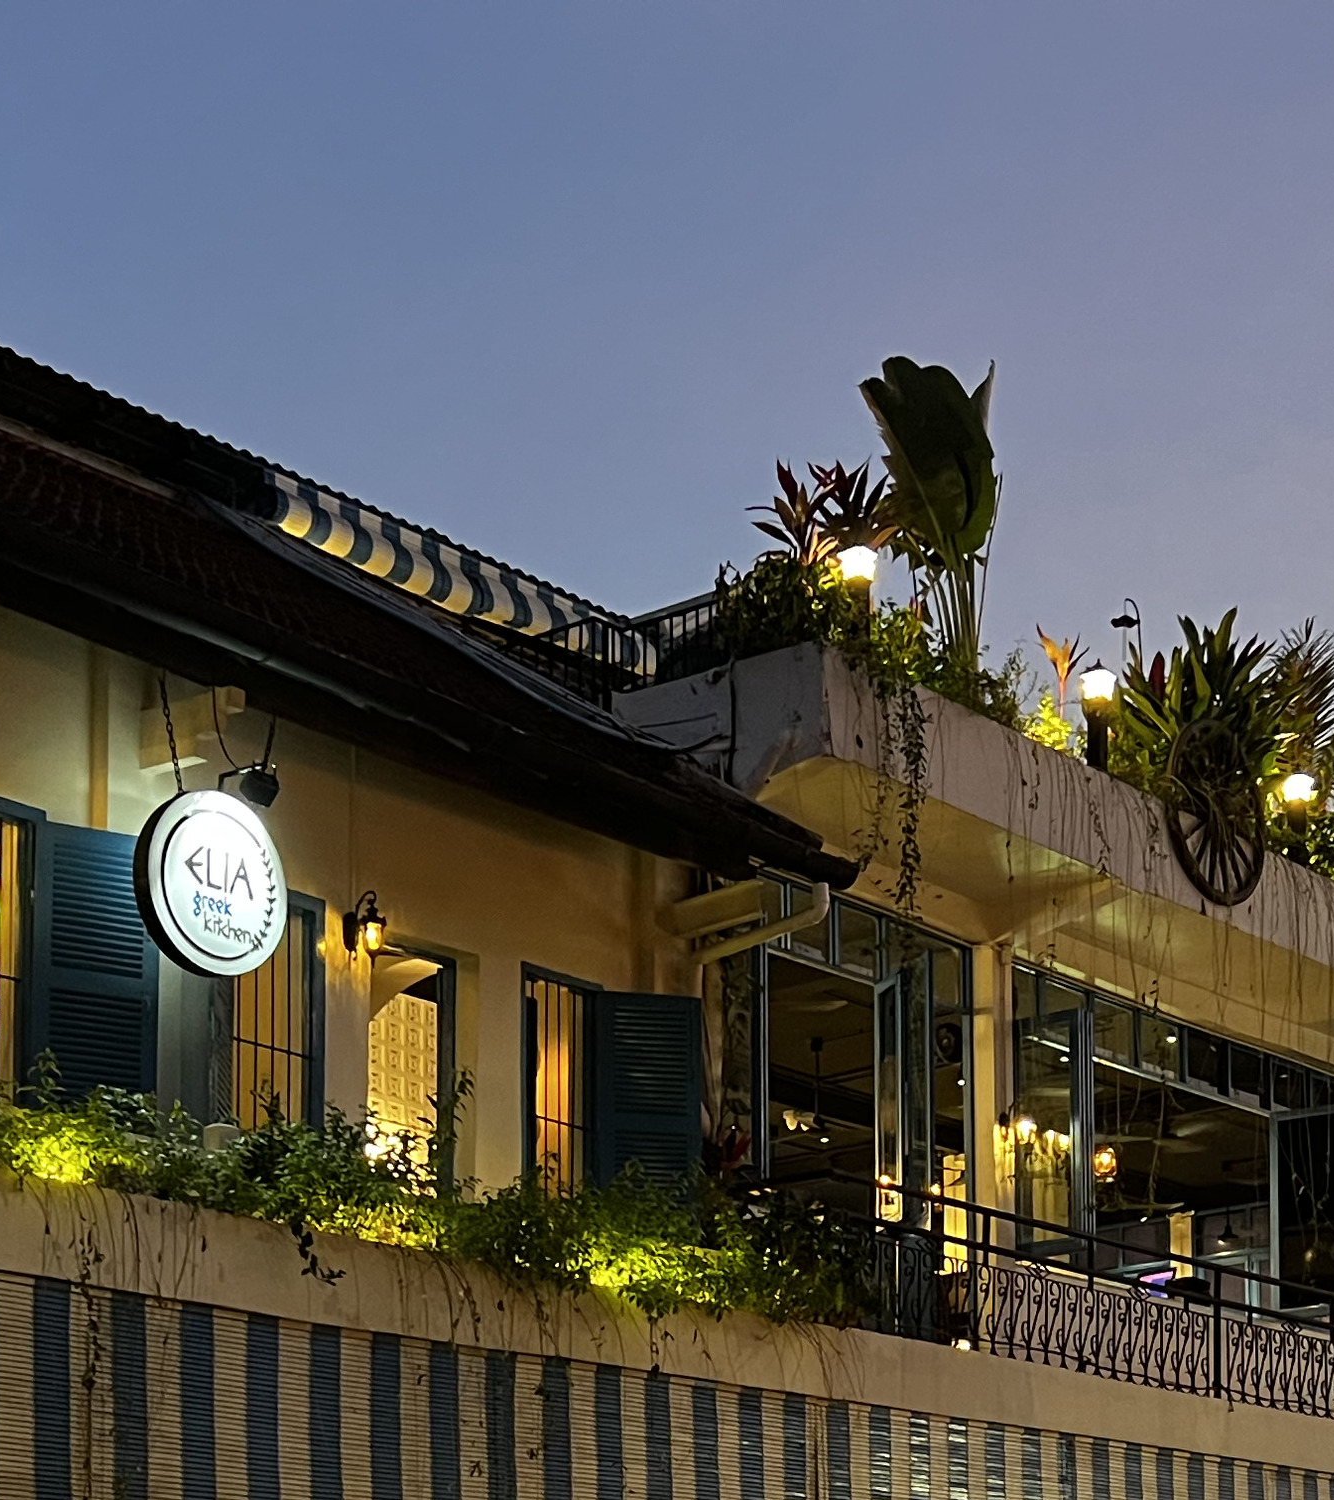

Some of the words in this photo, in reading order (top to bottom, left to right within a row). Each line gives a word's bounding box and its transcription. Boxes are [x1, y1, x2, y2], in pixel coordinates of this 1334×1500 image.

[184, 846, 254, 901] ELIA
[192, 891, 233, 917] greek
[203, 911, 253, 945] kitchen
